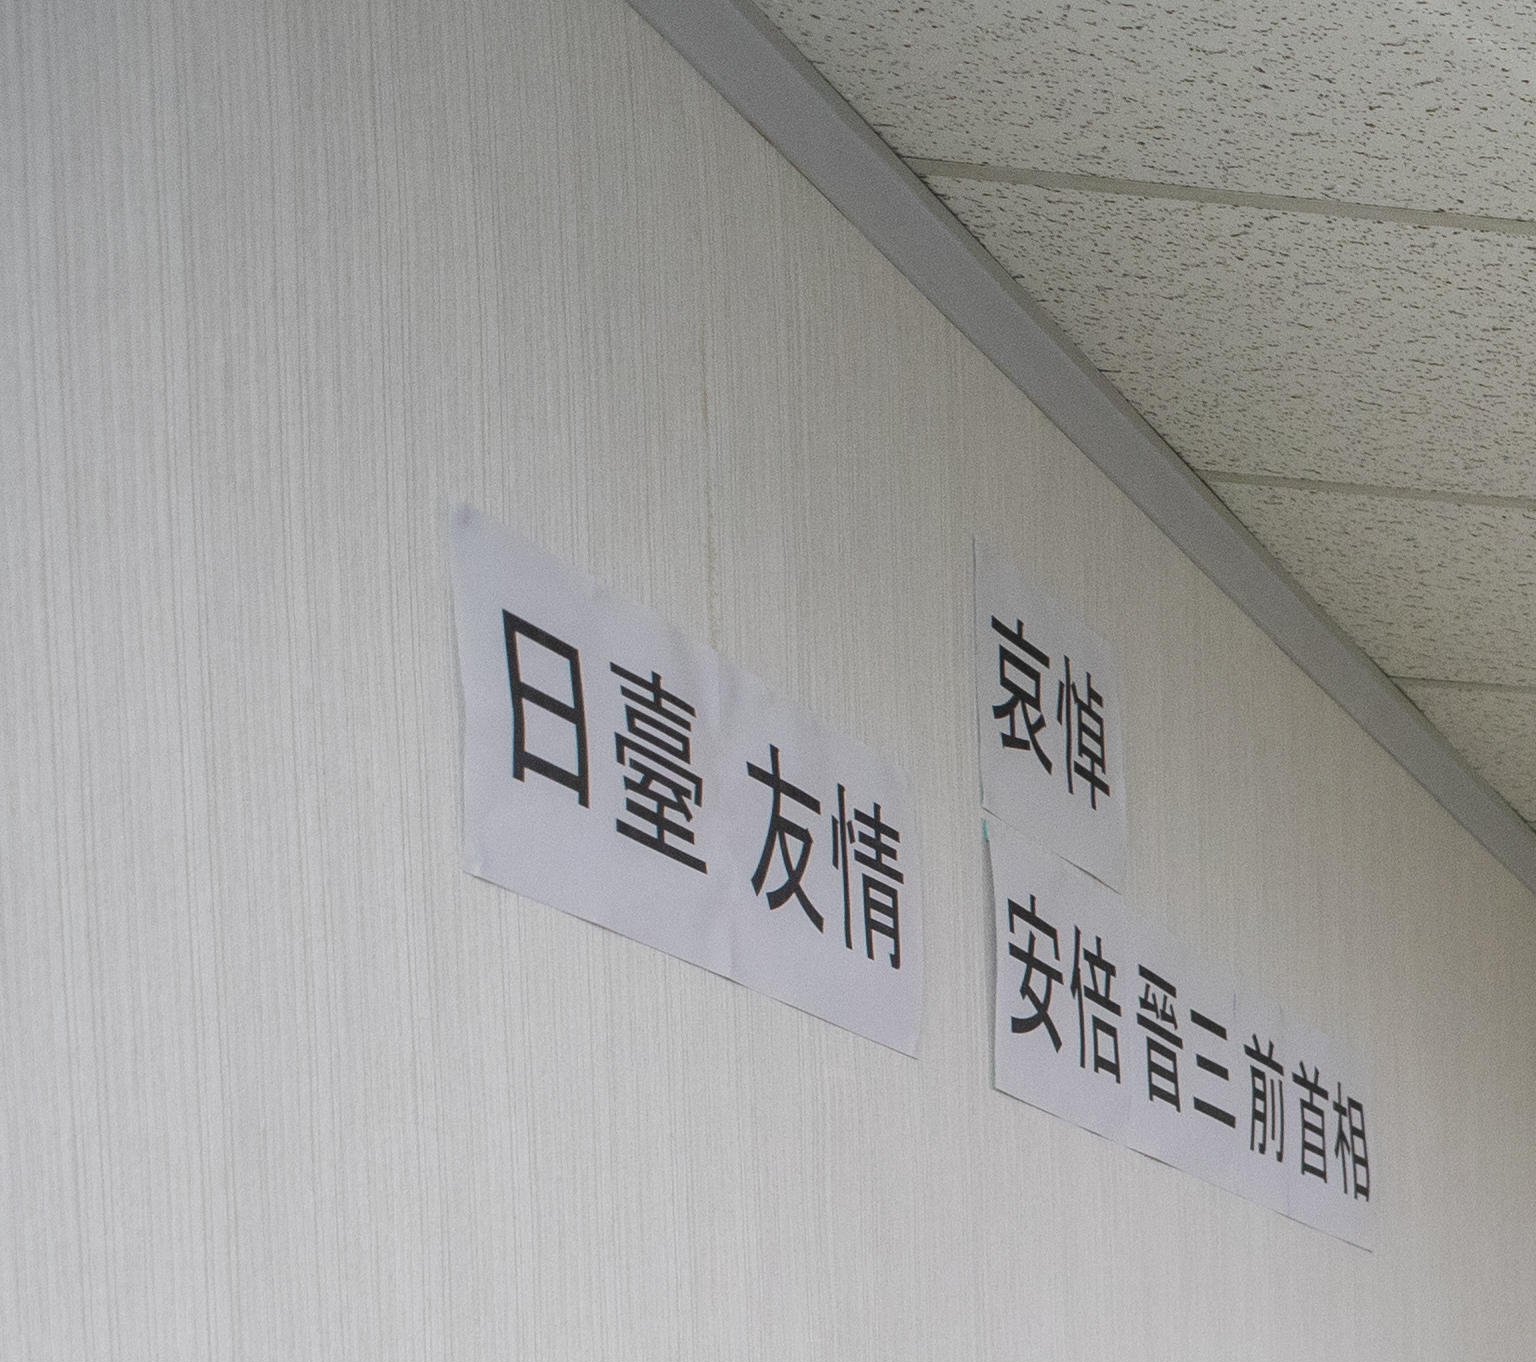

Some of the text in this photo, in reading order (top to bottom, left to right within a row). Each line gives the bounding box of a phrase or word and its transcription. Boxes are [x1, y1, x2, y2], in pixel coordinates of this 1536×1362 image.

[500, 608, 905, 970] 日臺 友情
[989, 613, 1111, 810] 哀悼
[1006, 893, 1371, 1202] 安倍晉三前首相
